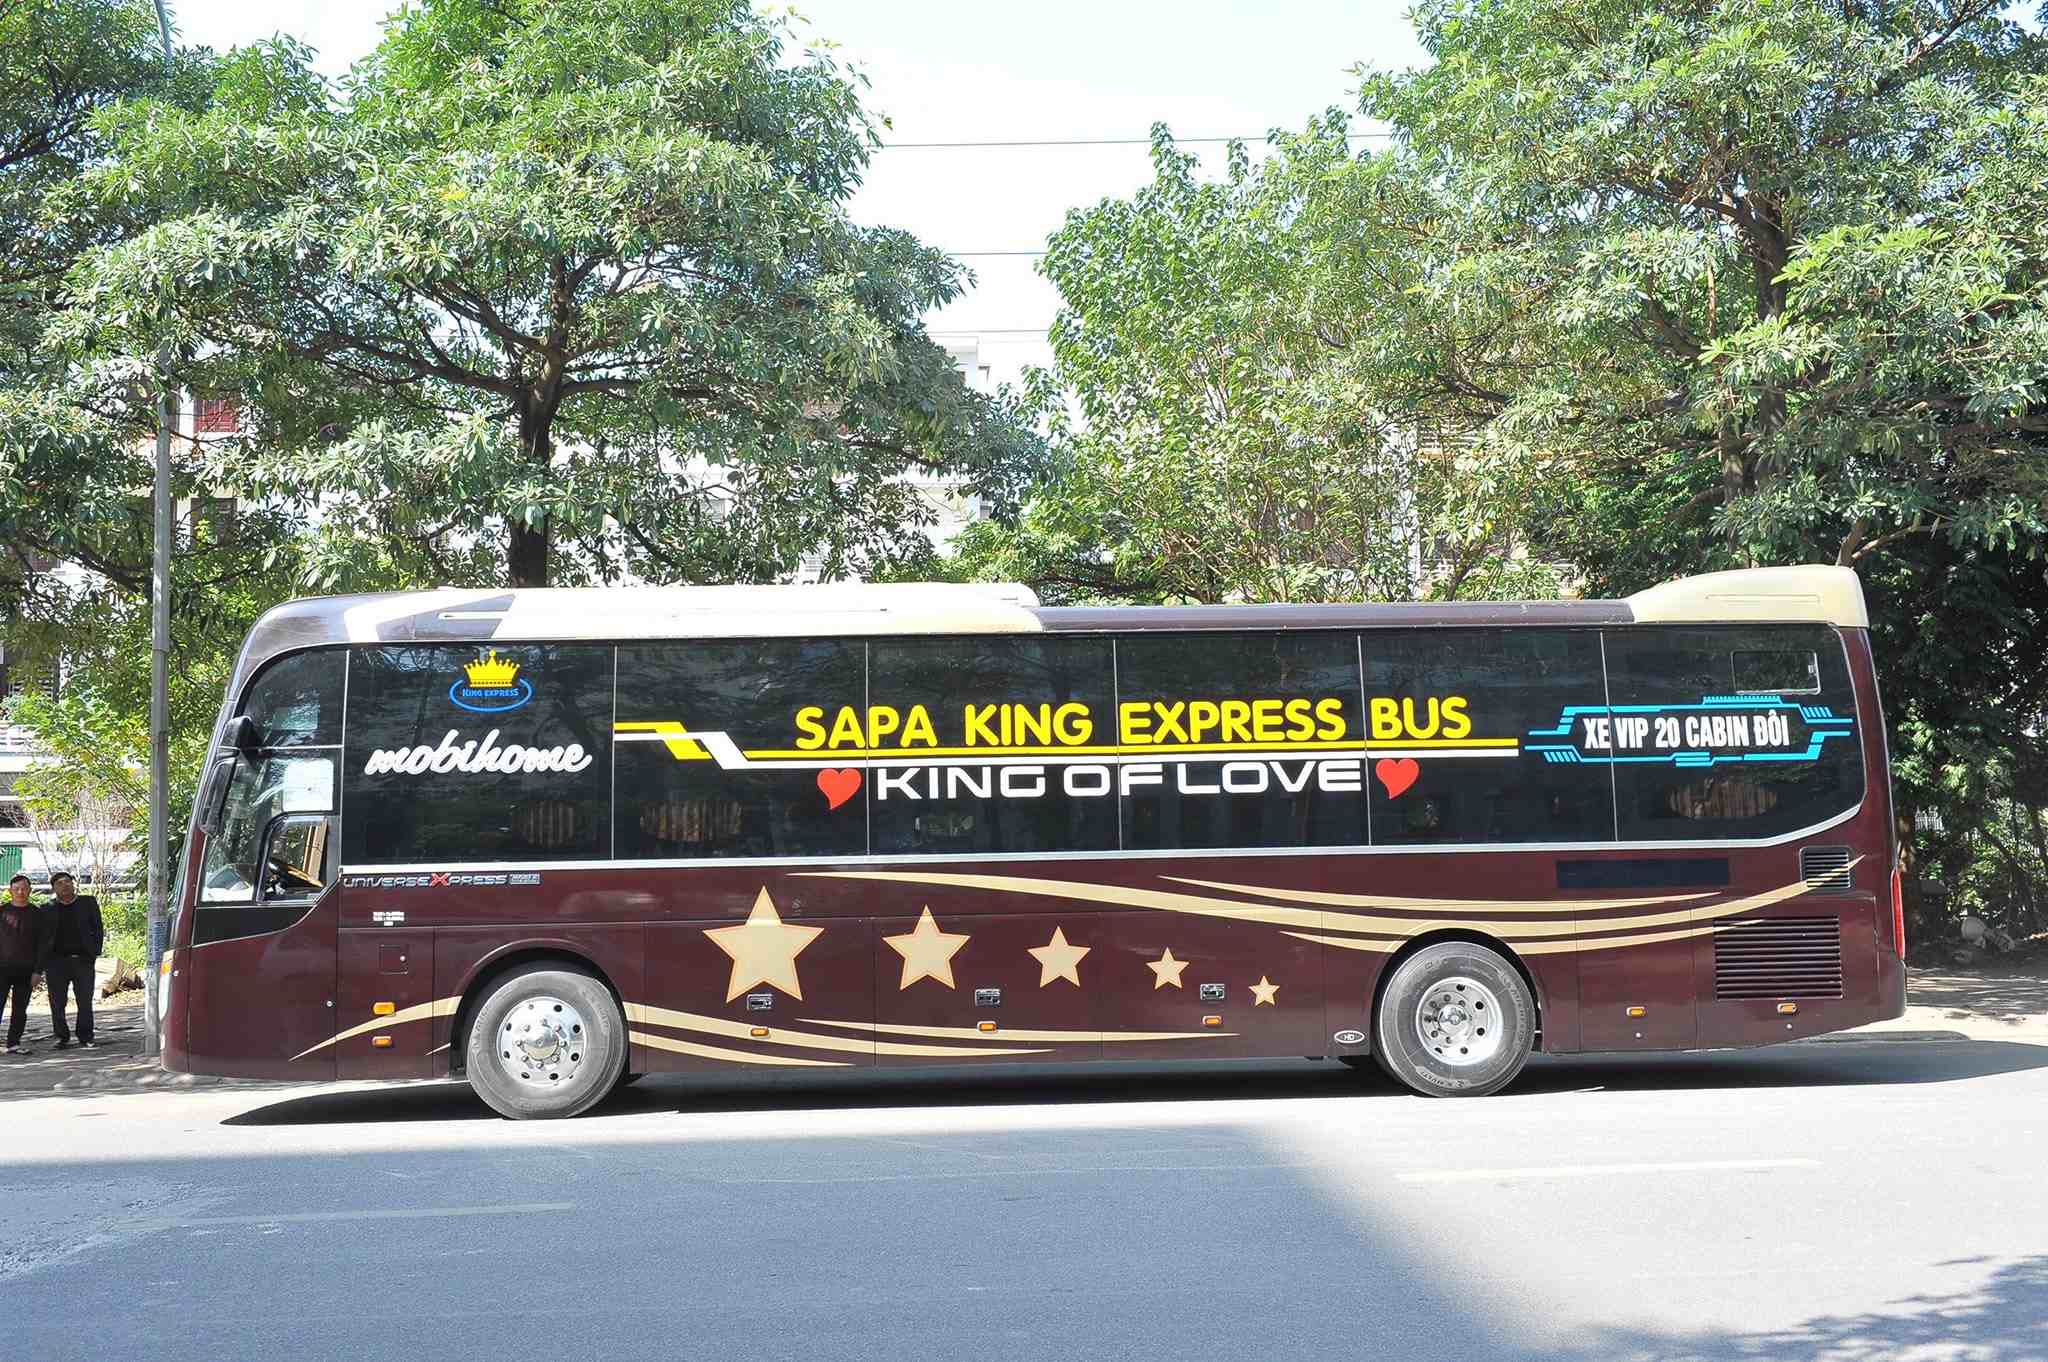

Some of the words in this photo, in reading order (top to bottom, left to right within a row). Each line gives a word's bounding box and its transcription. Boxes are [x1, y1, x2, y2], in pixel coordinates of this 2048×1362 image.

[484, 687, 520, 697] EXPRESS
[795, 704, 939, 750] SAPA
[964, 702, 1094, 746] KING
[1119, 698, 1347, 745] EXPRESS
[1370, 696, 1472, 740] BUS
[1582, 717, 1611, 750] XE
[1614, 717, 1649, 749] VIP
[1654, 716, 1681, 748] 20
[1685, 715, 1751, 748] CABIN
[1753, 709, 1791, 747] ĐÔI
[363, 728, 593, 776] mobihome
[877, 765, 1047, 801] KING
[1063, 763, 1163, 797] OF
[1177, 760, 1362, 795] LOVE
